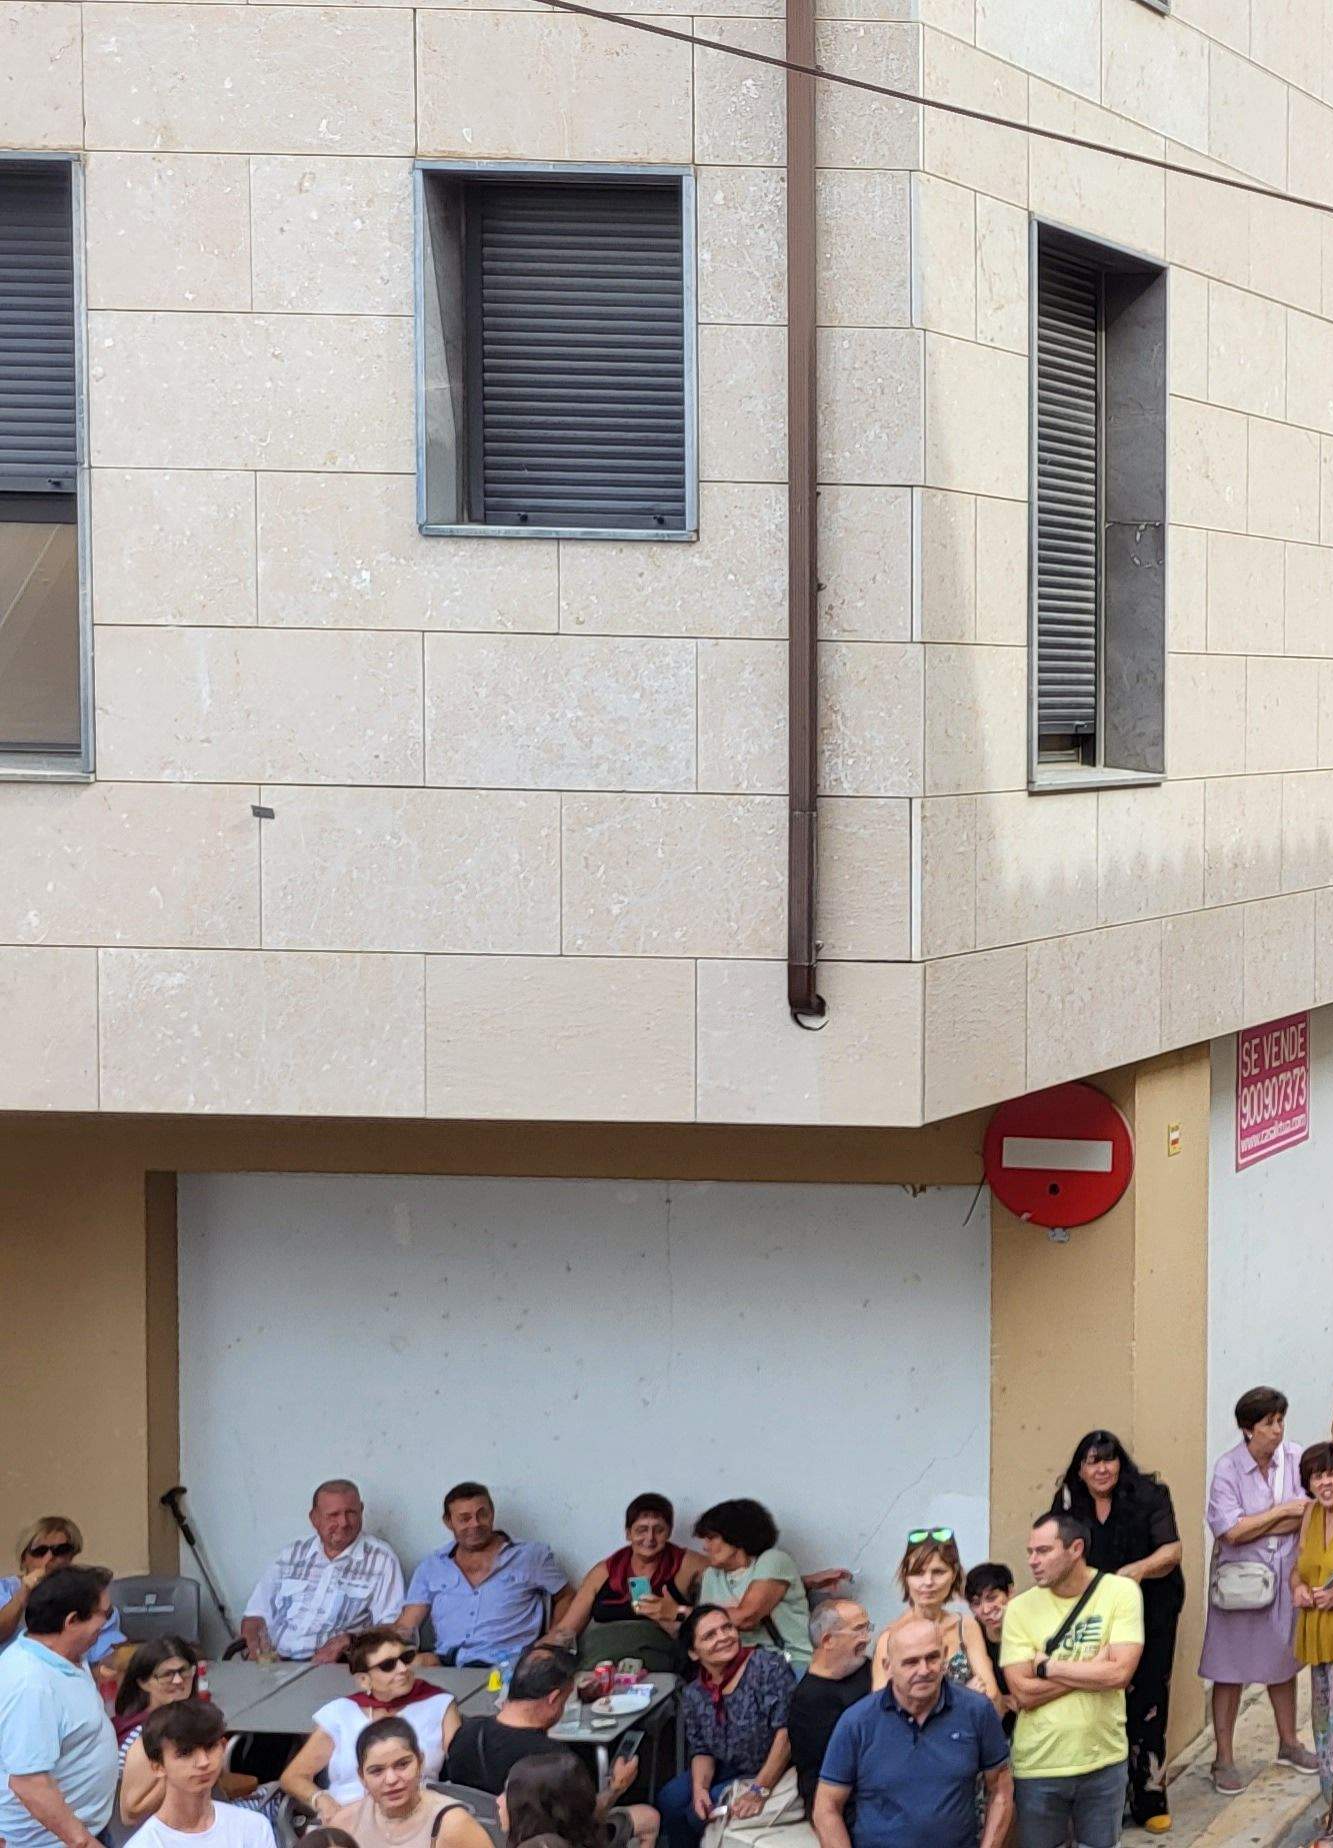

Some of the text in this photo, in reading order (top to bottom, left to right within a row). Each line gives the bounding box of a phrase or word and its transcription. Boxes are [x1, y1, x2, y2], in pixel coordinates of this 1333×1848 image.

[1242, 1022, 1306, 1077] SE VENDE
[1241, 1065, 1307, 1130] 900907373
